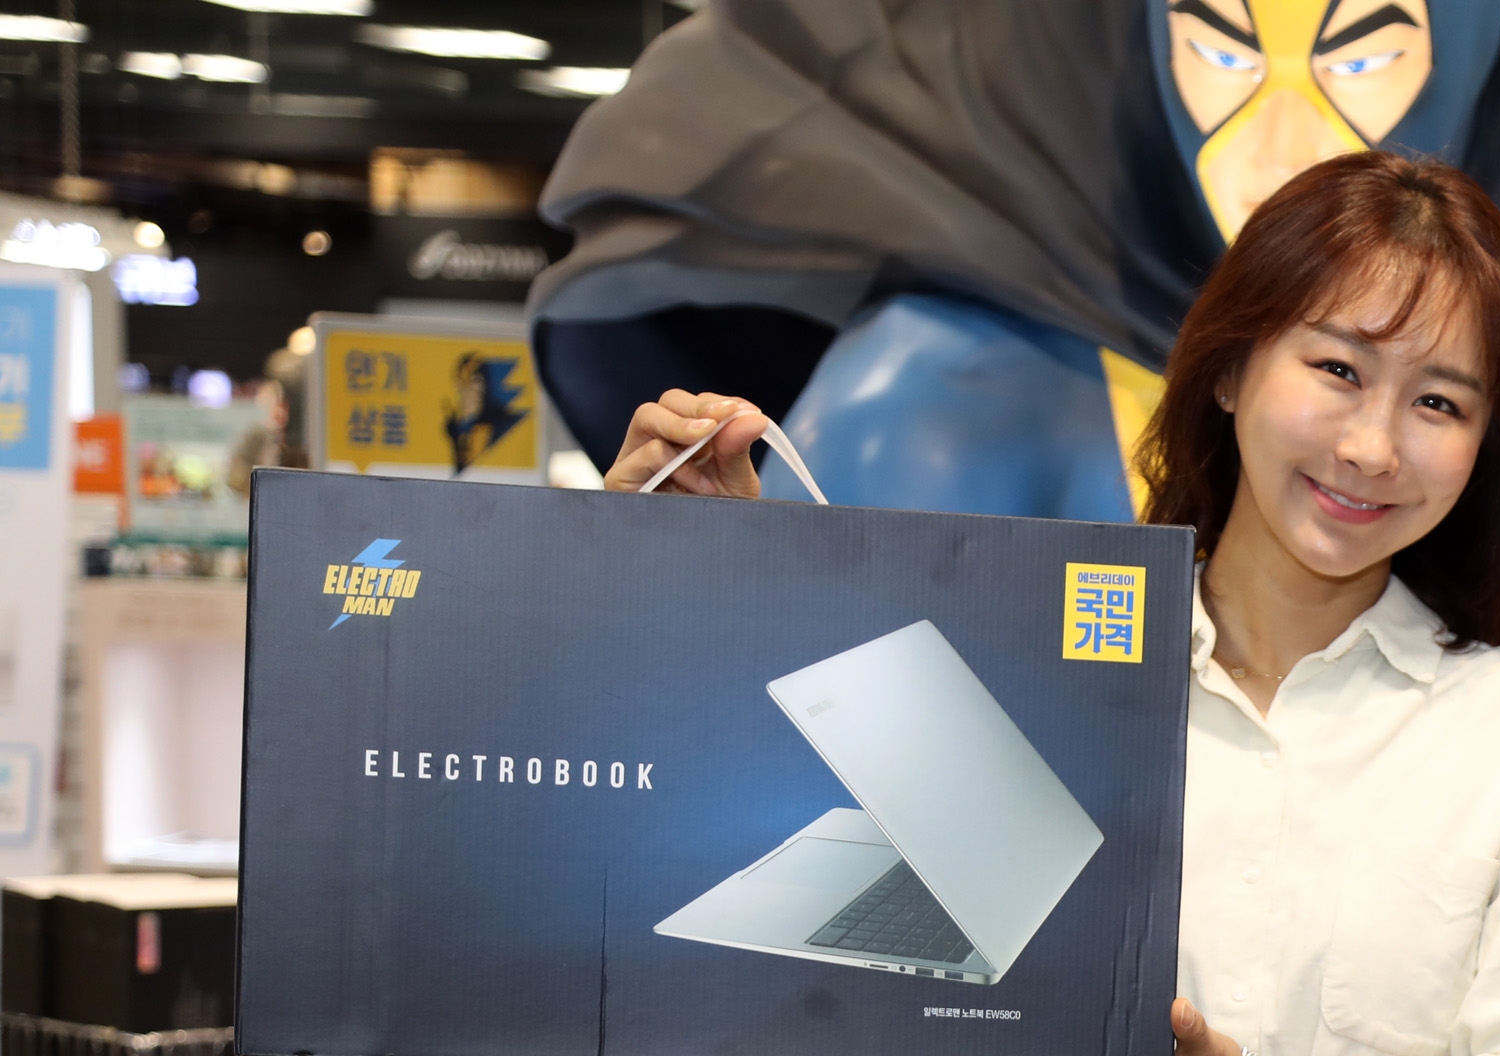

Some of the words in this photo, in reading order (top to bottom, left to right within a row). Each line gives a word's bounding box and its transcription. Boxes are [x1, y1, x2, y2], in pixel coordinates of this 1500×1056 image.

[323, 564, 422, 598] ELECTRO
[1078, 571, 1135, 587] 에브리데이
[342, 598, 394, 617] MAN
[1075, 587, 1134, 620] 국민
[1074, 622, 1133, 656] 가격
[365, 749, 654, 790] ELECTROBOOK
[924, 1007, 960, 1018] 일렉트로맨
[962, 1008, 984, 1019] 노트북
